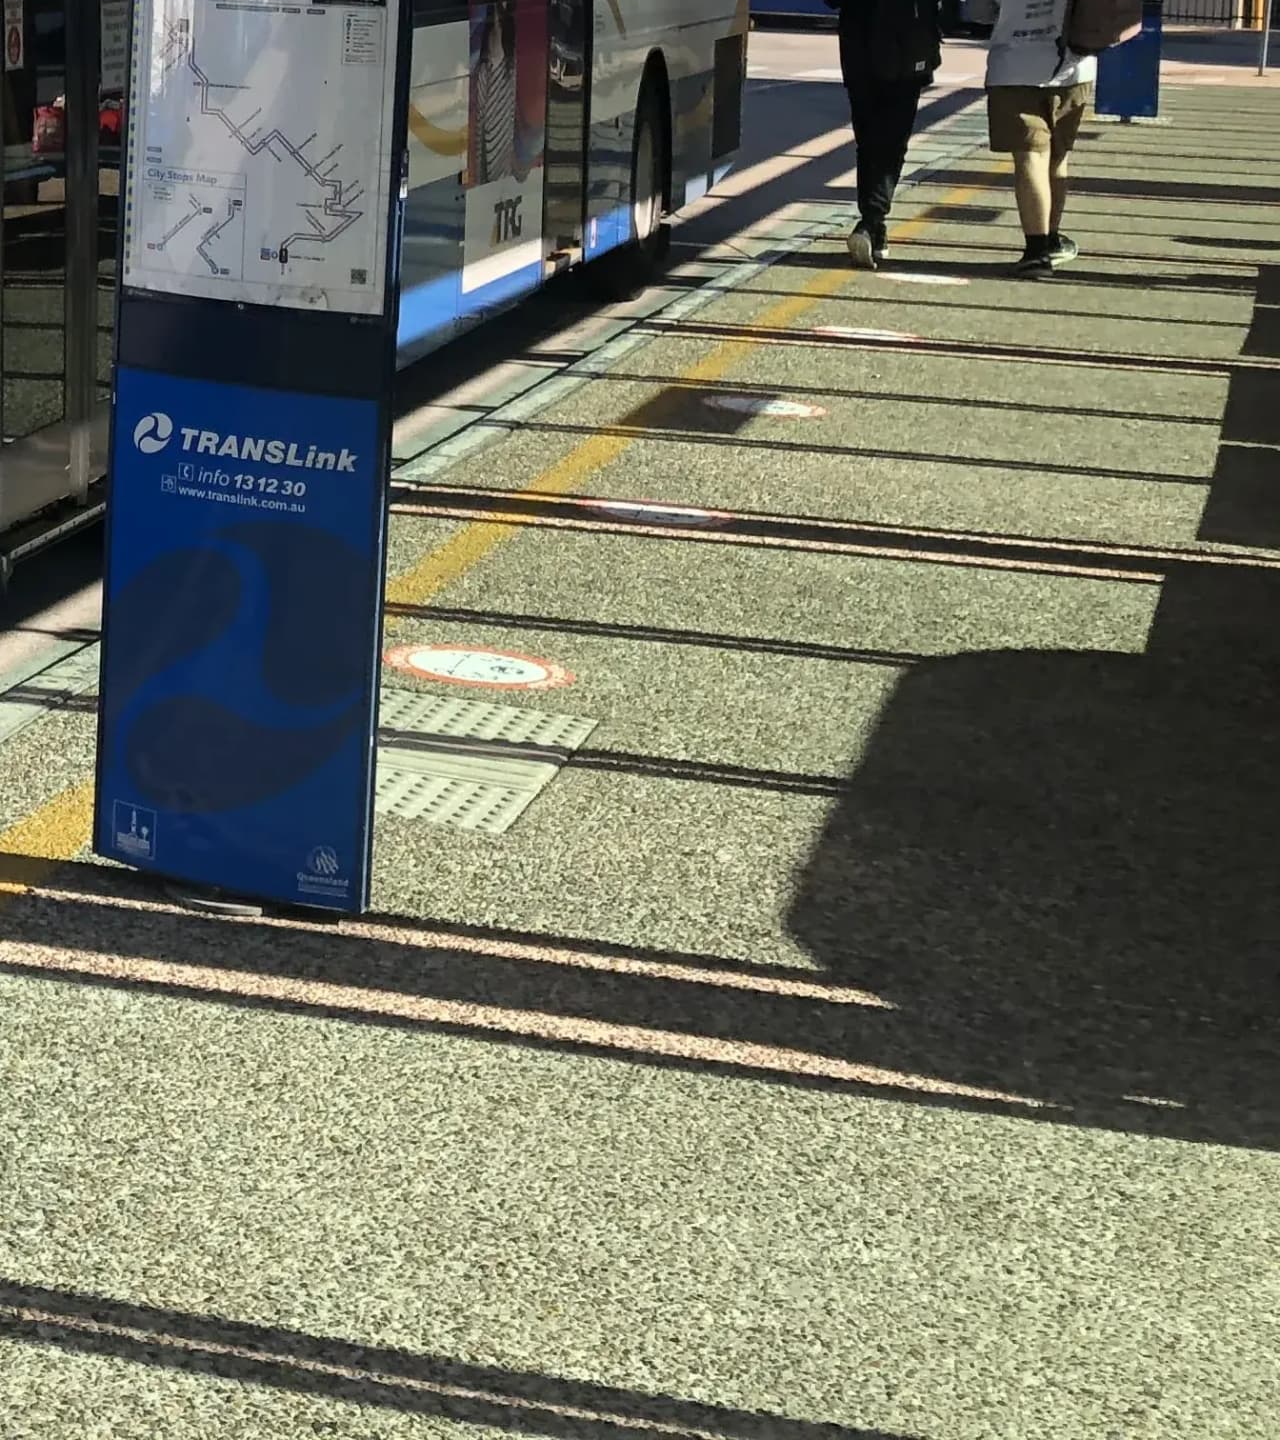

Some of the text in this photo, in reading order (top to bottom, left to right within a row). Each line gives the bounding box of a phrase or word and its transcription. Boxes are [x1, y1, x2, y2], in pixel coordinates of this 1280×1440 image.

[180, 428, 360, 472] TRANSLink
[198, 467, 306, 497] info 13 12 30
[178, 485, 306, 513] www.translink.com.au
